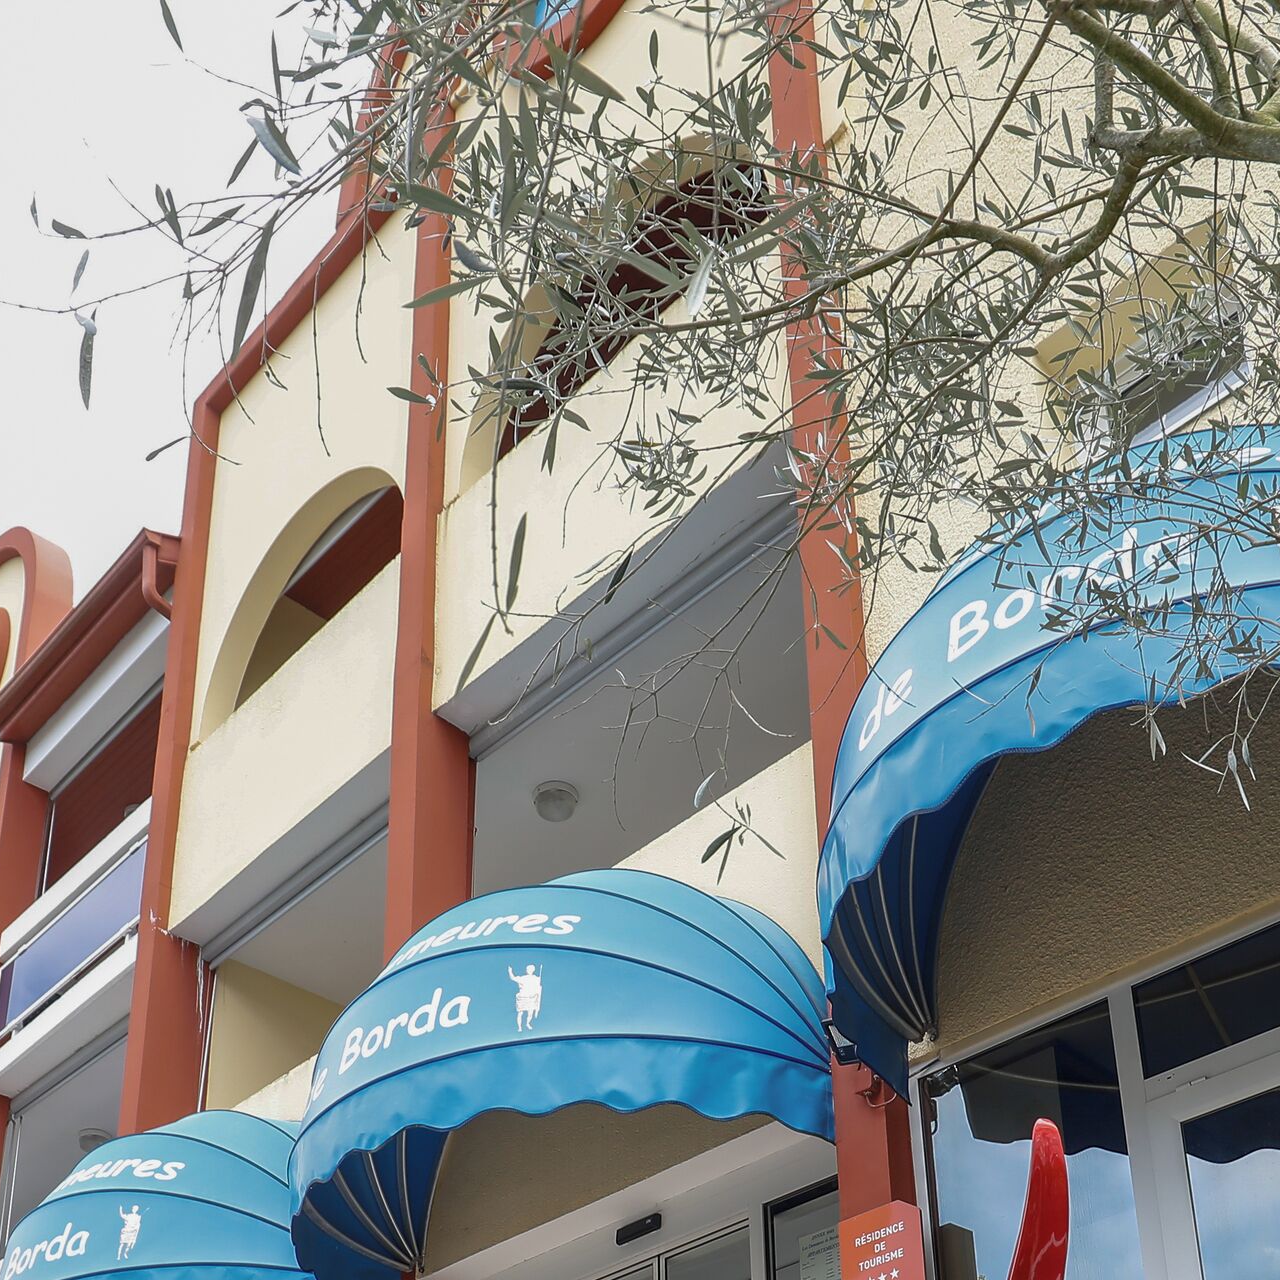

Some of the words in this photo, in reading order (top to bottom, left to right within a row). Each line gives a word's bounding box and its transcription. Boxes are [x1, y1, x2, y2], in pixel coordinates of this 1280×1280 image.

[858, 668, 913, 752] de
[947, 525, 1199, 663] Borda
[338, 987, 470, 1076] Borda
[854, 1221, 905, 1248] RÉSIDENCE
[874, 1241, 887, 1254] DE
[858, 1248, 904, 1272] TOURISME
